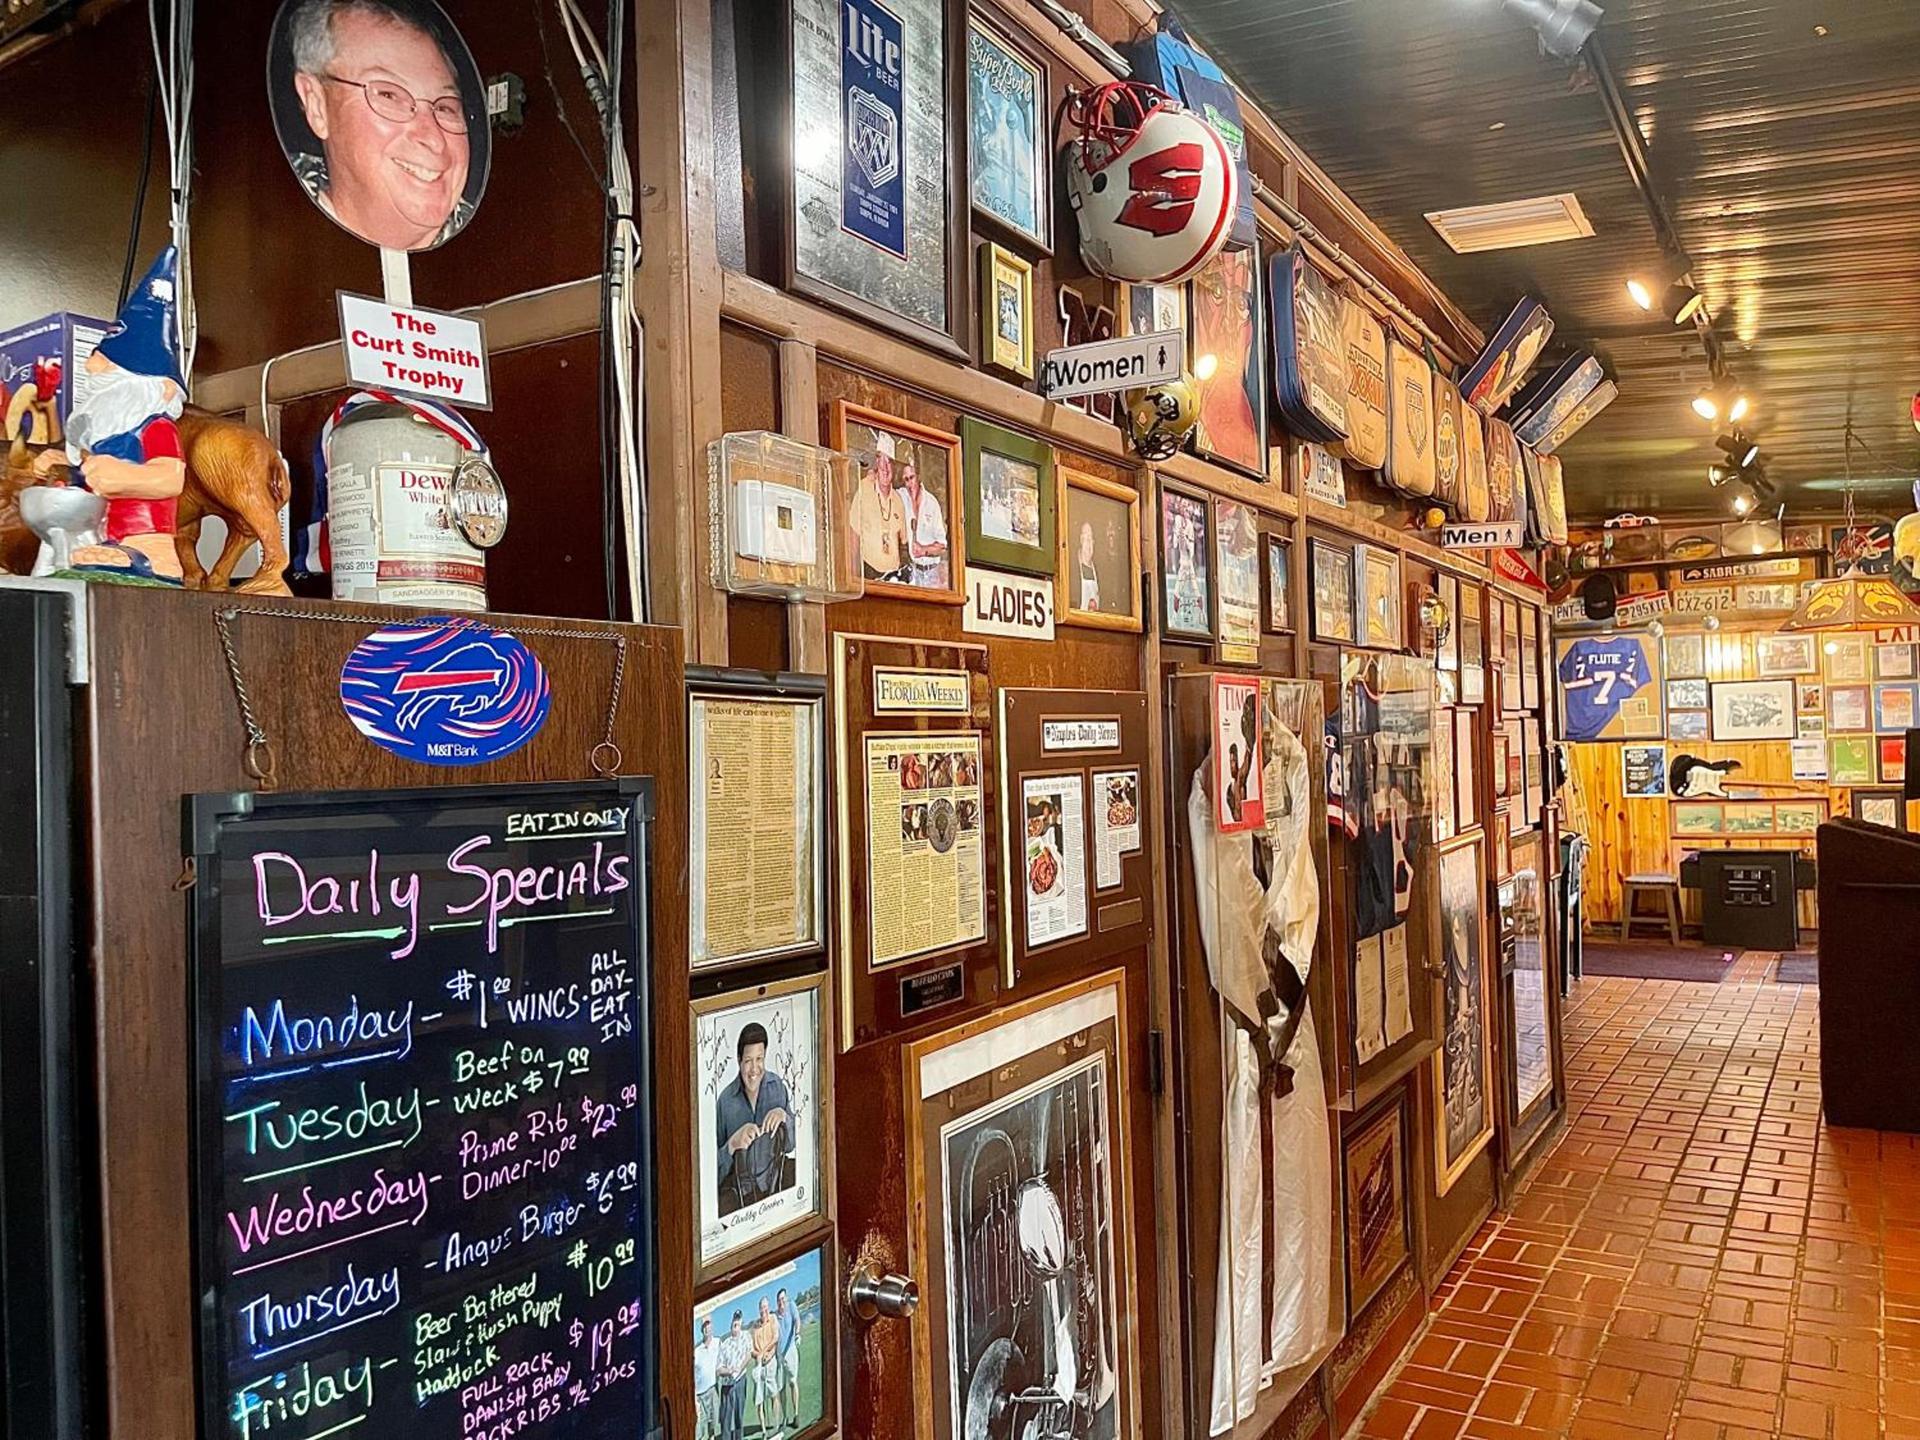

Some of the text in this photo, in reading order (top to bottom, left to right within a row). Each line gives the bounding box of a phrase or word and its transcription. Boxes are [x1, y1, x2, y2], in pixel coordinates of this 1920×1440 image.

[845, 2, 900, 75] Lite
[970, 34, 1003, 80] Super
[876, 67, 900, 91] BEER
[392, 312, 436, 335] The
[352, 330, 480, 368] Curt Smith
[382, 361, 464, 394] Trophy
[1053, 354, 1145, 387] Women
[400, 470, 452, 489] Dew
[1446, 529, 1497, 544] Men
[356, 561, 375, 570] 2015
[1703, 565, 1746, 578] SABRES
[976, 582, 1046, 629] LADIES
[1677, 596, 1729, 611] CXZ-612
[1575, 663, 1585, 678] 7
[1589, 654, 1621, 664] FLUTIE
[881, 680, 965, 704] FLORIDA WEEKLY
[1594, 671, 1616, 704] 7
[427, 744, 479, 757] M&T Bank
[1078, 724, 1097, 744] Daily
[1098, 724, 1117, 741] News
[507, 807, 630, 834] EAT IN ONLY
[252, 835, 630, 959] Daily Specials
[591, 950, 627, 974] ALL
[591, 991, 631, 1023] EAT
[601, 1013, 632, 1043] IN
[455, 1040, 545, 1083] Beef on
[459, 1130, 519, 1167] Prime
[527, 1102, 568, 1142] Rib
[240, 1263, 400, 1344] Thursday
[415, 1271, 537, 1346] Beer Battered
[477, 1311, 518, 1345] Hush
[522, 1292, 563, 1329] Puppy
[416, 1345, 501, 1402] Haddock
[461, 1375, 503, 1409] FULL
[463, 1361, 571, 1434] DANISH BABY
[463, 1418, 516, 1440] ACK
[517, 1395, 561, 1432] RIBS
